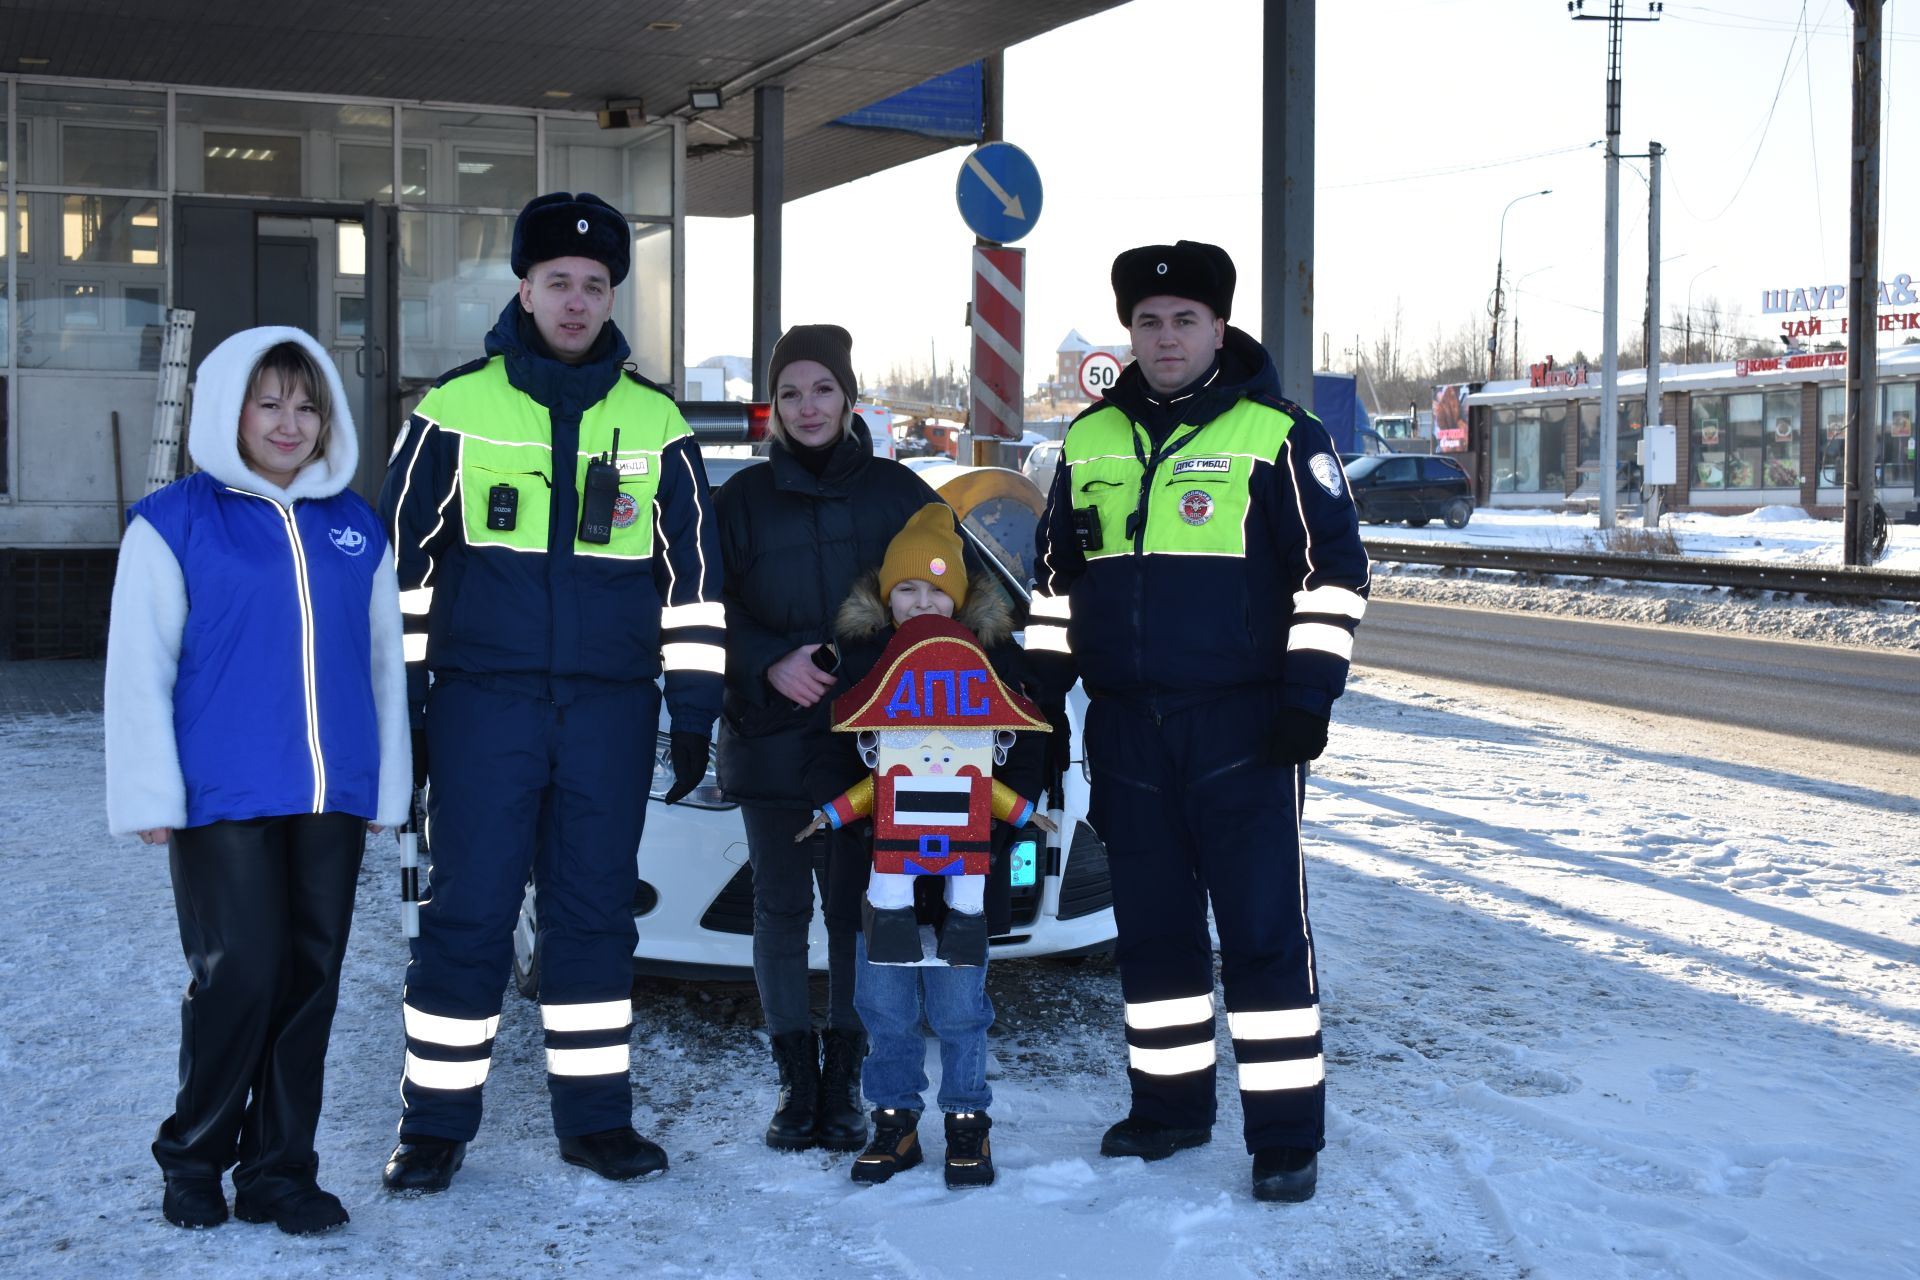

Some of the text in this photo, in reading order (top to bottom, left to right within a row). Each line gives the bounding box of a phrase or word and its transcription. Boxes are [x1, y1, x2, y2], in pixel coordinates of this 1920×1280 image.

[1762, 273, 1919, 314] ШАУРА&
[1781, 316, 1822, 337] ЧАЙ
[1089, 366, 1114, 386] 50
[618, 461, 645, 471] ИБДД
[1175, 460, 1227, 472] ДПС ГИБДД
[587, 523, 609, 537] 4852
[884, 669, 990, 719] ДПС
